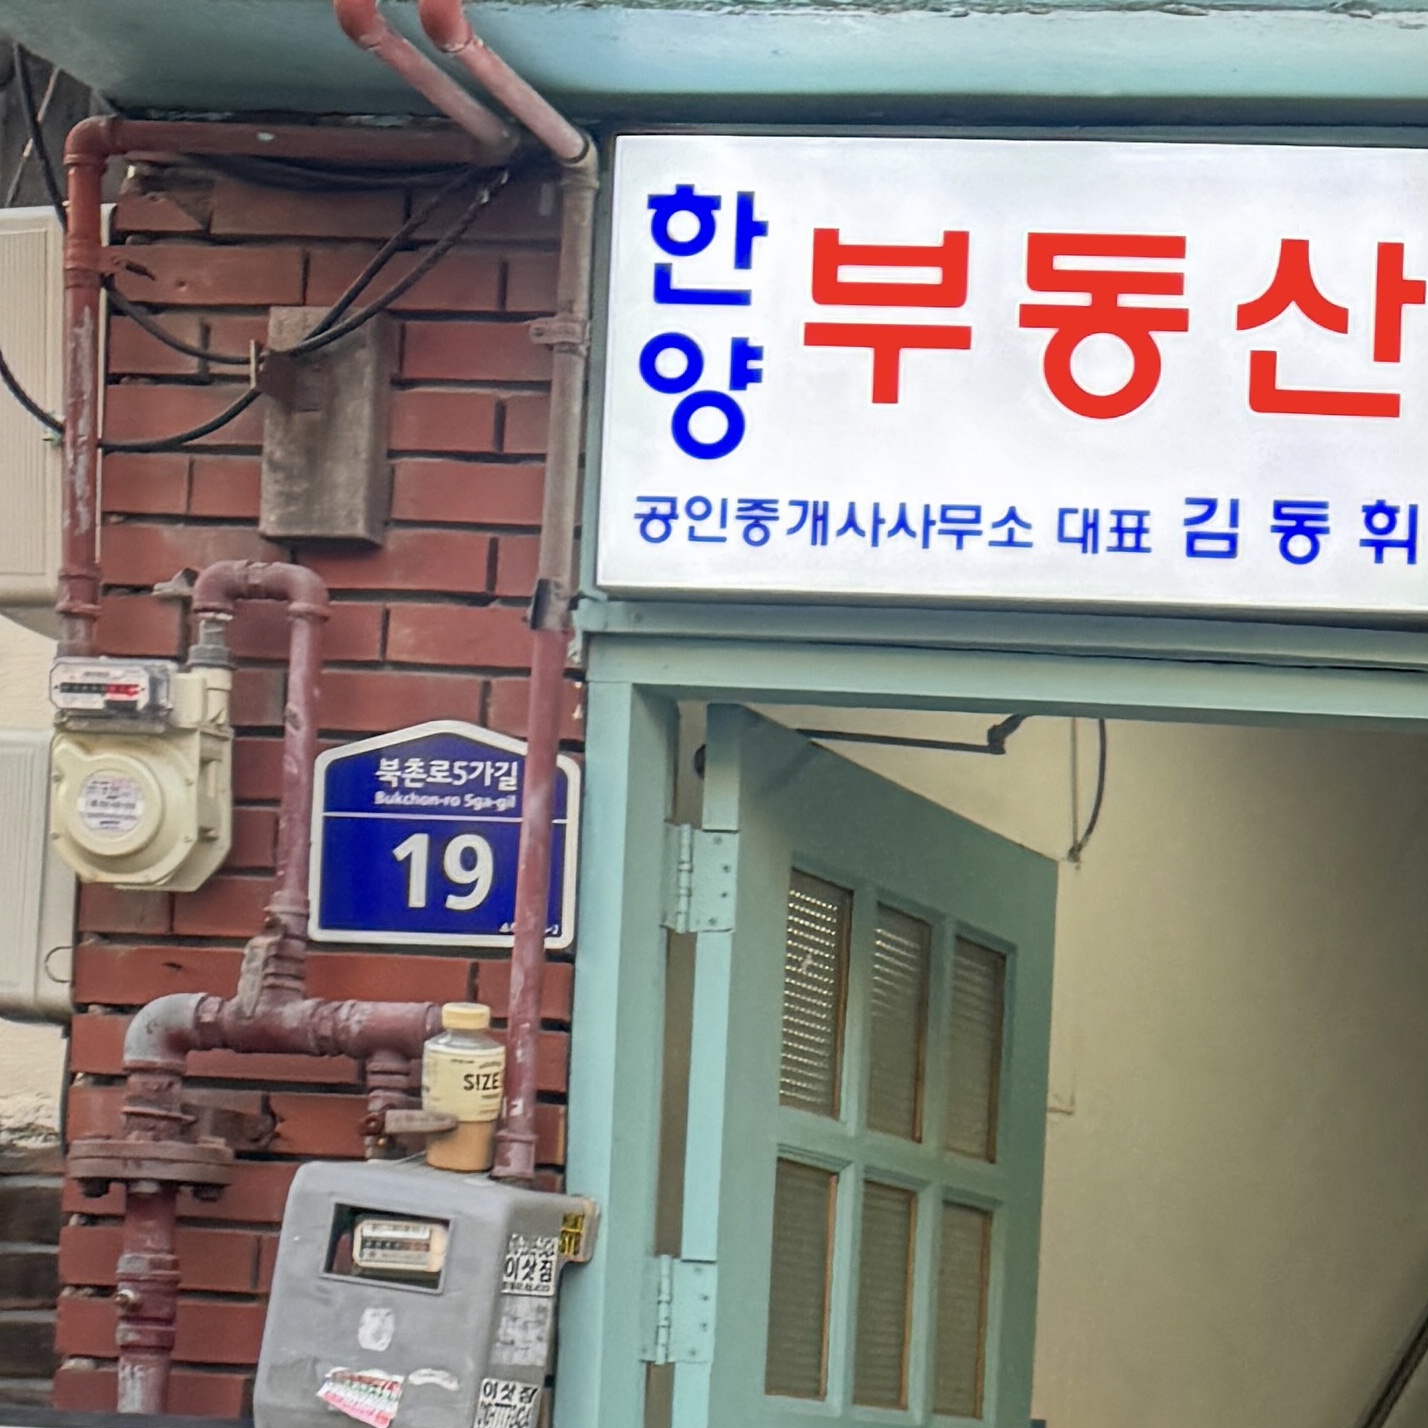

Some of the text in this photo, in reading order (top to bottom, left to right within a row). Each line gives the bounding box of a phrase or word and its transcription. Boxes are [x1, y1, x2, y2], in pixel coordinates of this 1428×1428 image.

[638, 181, 769, 461] 한양
[803, 226, 1427, 421] 부동산
[633, 494, 1419, 566] 공인중개사사무소 대표 김동휘
[374, 757, 519, 791] 북촌로5가길
[374, 791, 461, 808] Bukchon-ro
[392, 832, 494, 911] 19
